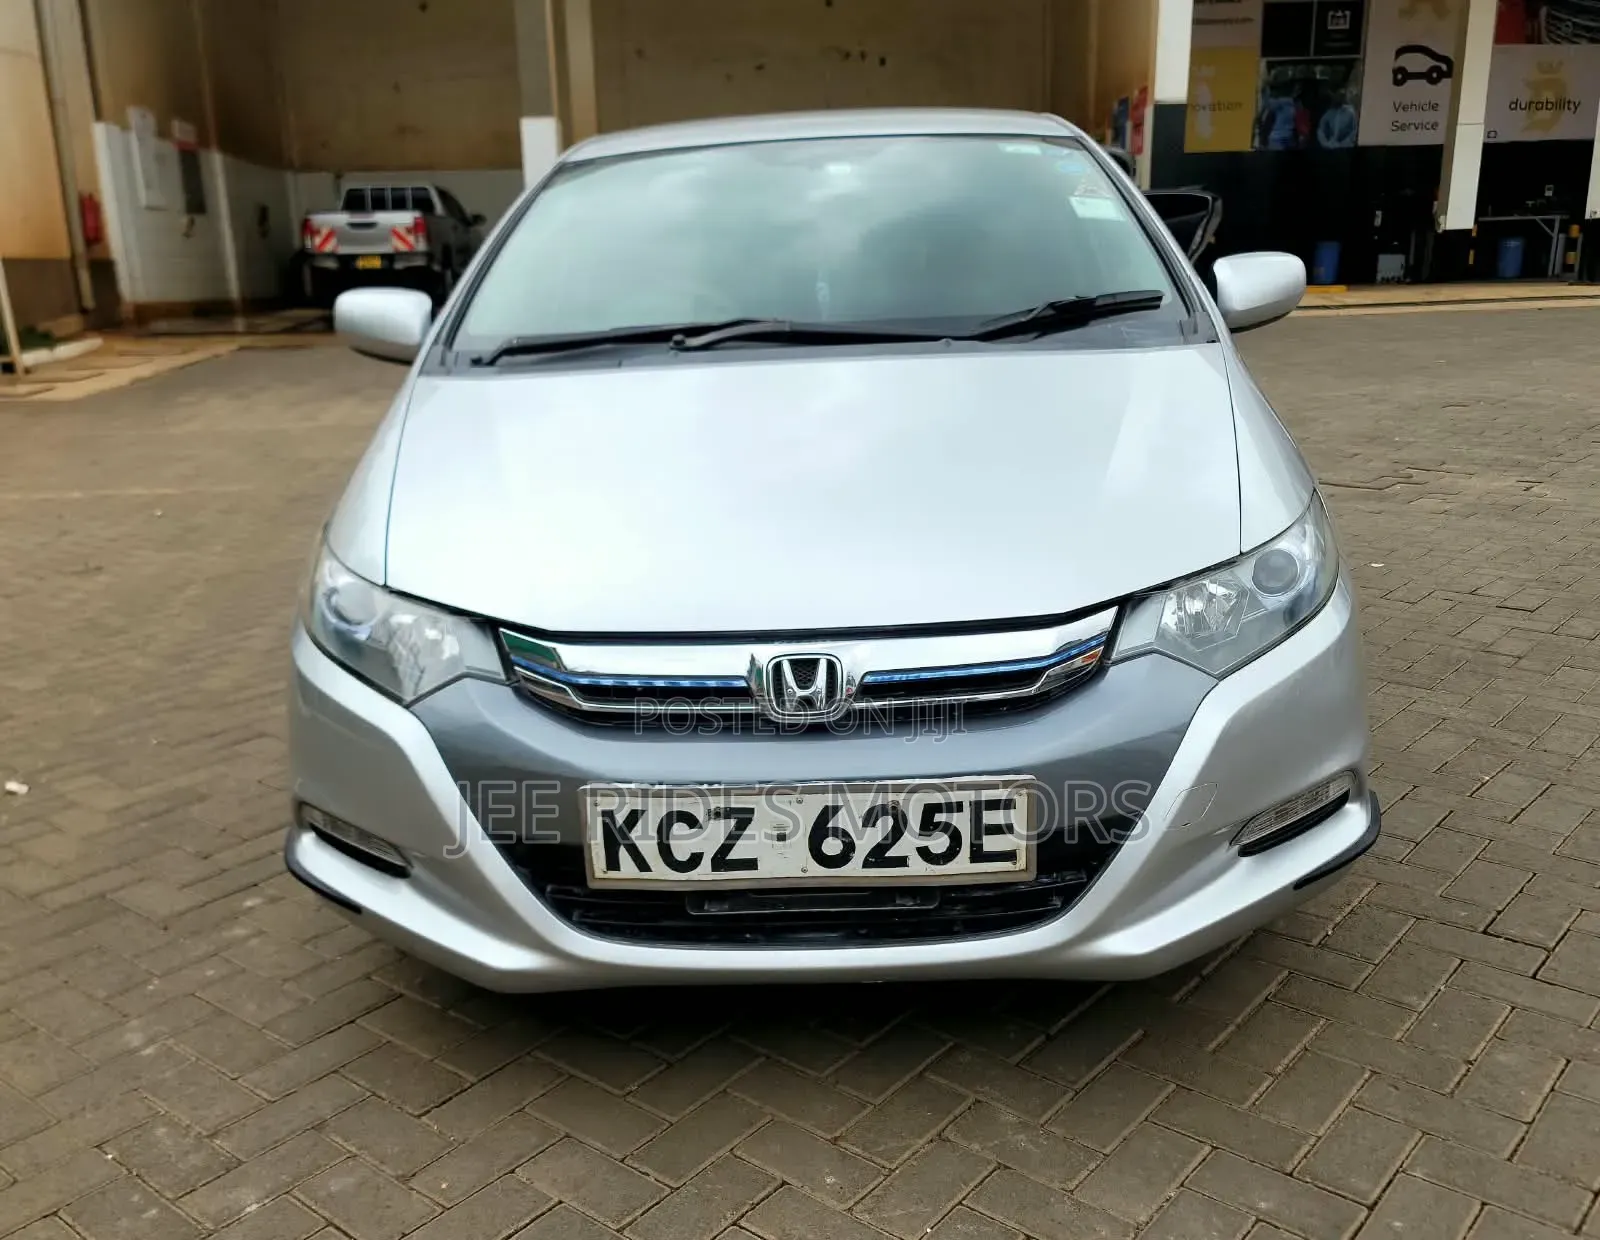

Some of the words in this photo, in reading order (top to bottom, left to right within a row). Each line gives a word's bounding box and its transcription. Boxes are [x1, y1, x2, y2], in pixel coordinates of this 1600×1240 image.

[1392, 100, 1440, 113] Vehicle
[1508, 97, 1581, 115] durability
[1391, 120, 1440, 132] Service
[600, 806, 760, 874] KCZ
[807, 797, 1018, 870] 625E
